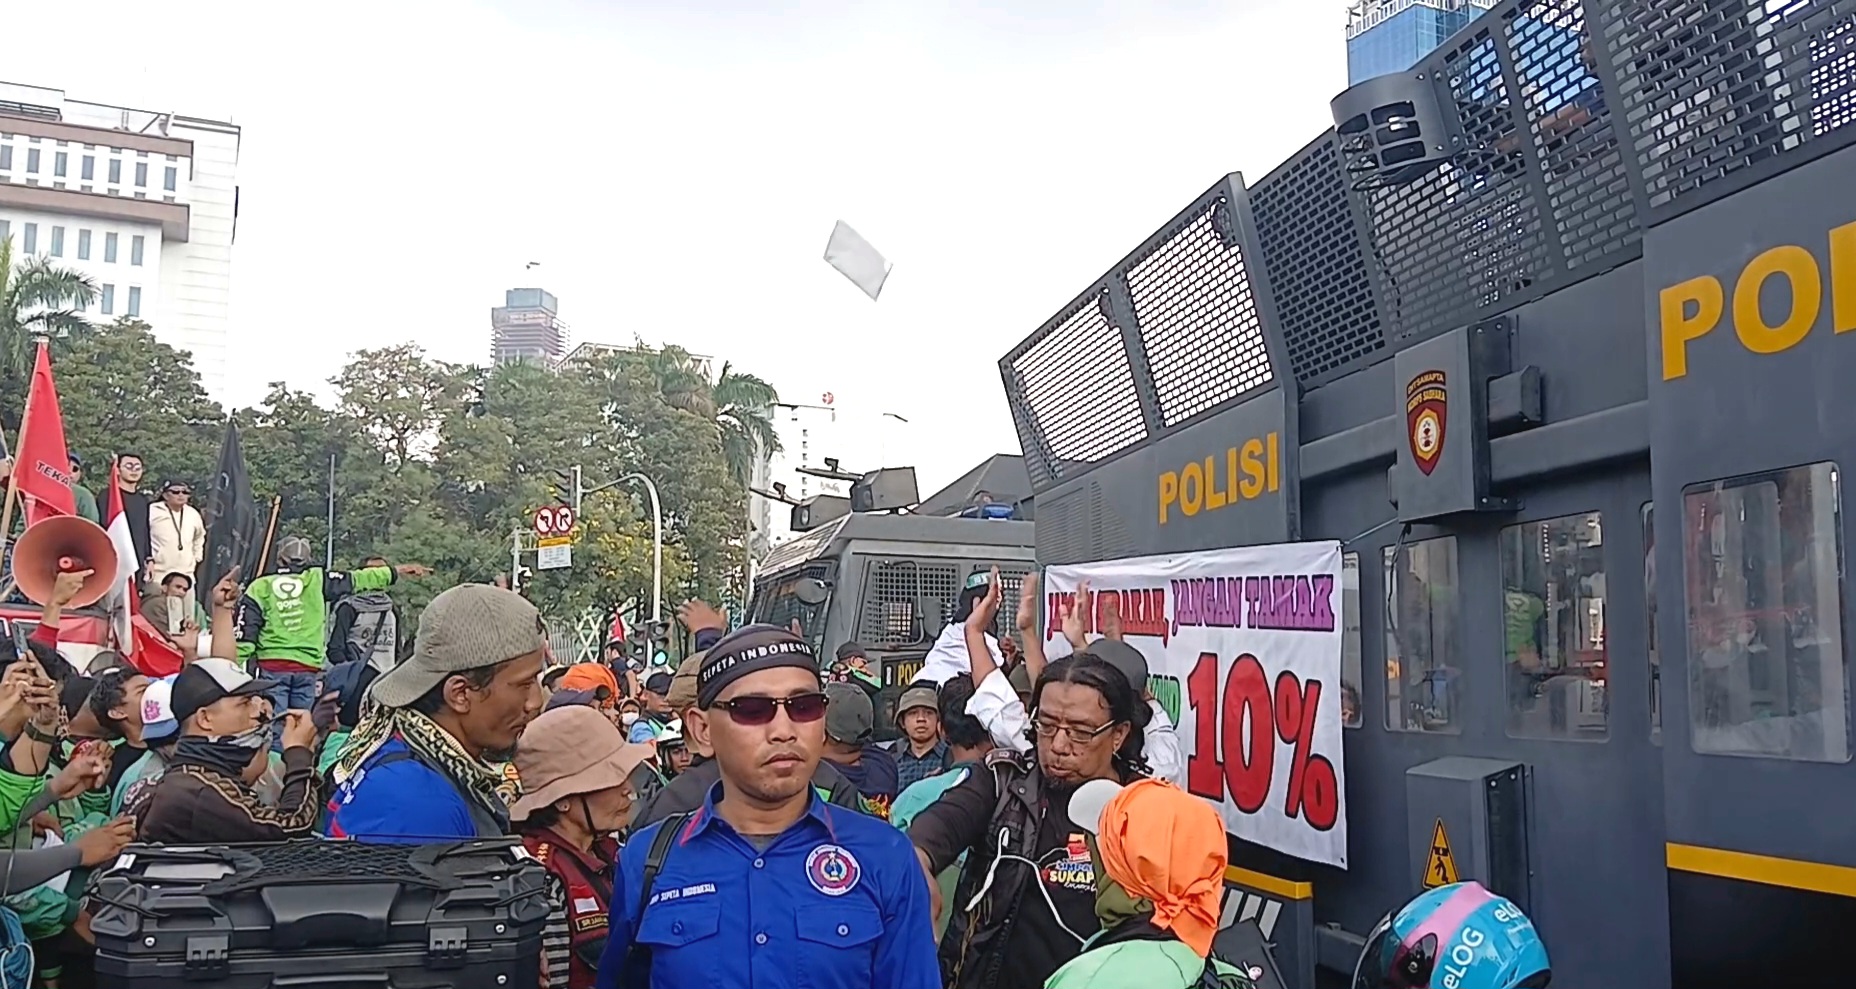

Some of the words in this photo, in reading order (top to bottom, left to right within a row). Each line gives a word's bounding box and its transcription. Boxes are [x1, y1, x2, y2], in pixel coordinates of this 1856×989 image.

[1158, 432, 1280, 524] POLISI
[1170, 577, 1243, 637] JANGAN
[1245, 573, 1335, 633] TAMAK
[740, 641, 813, 662] INDONESIA
[1187, 651, 1339, 831] 10%
[1443, 926, 1485, 989] eLOG
